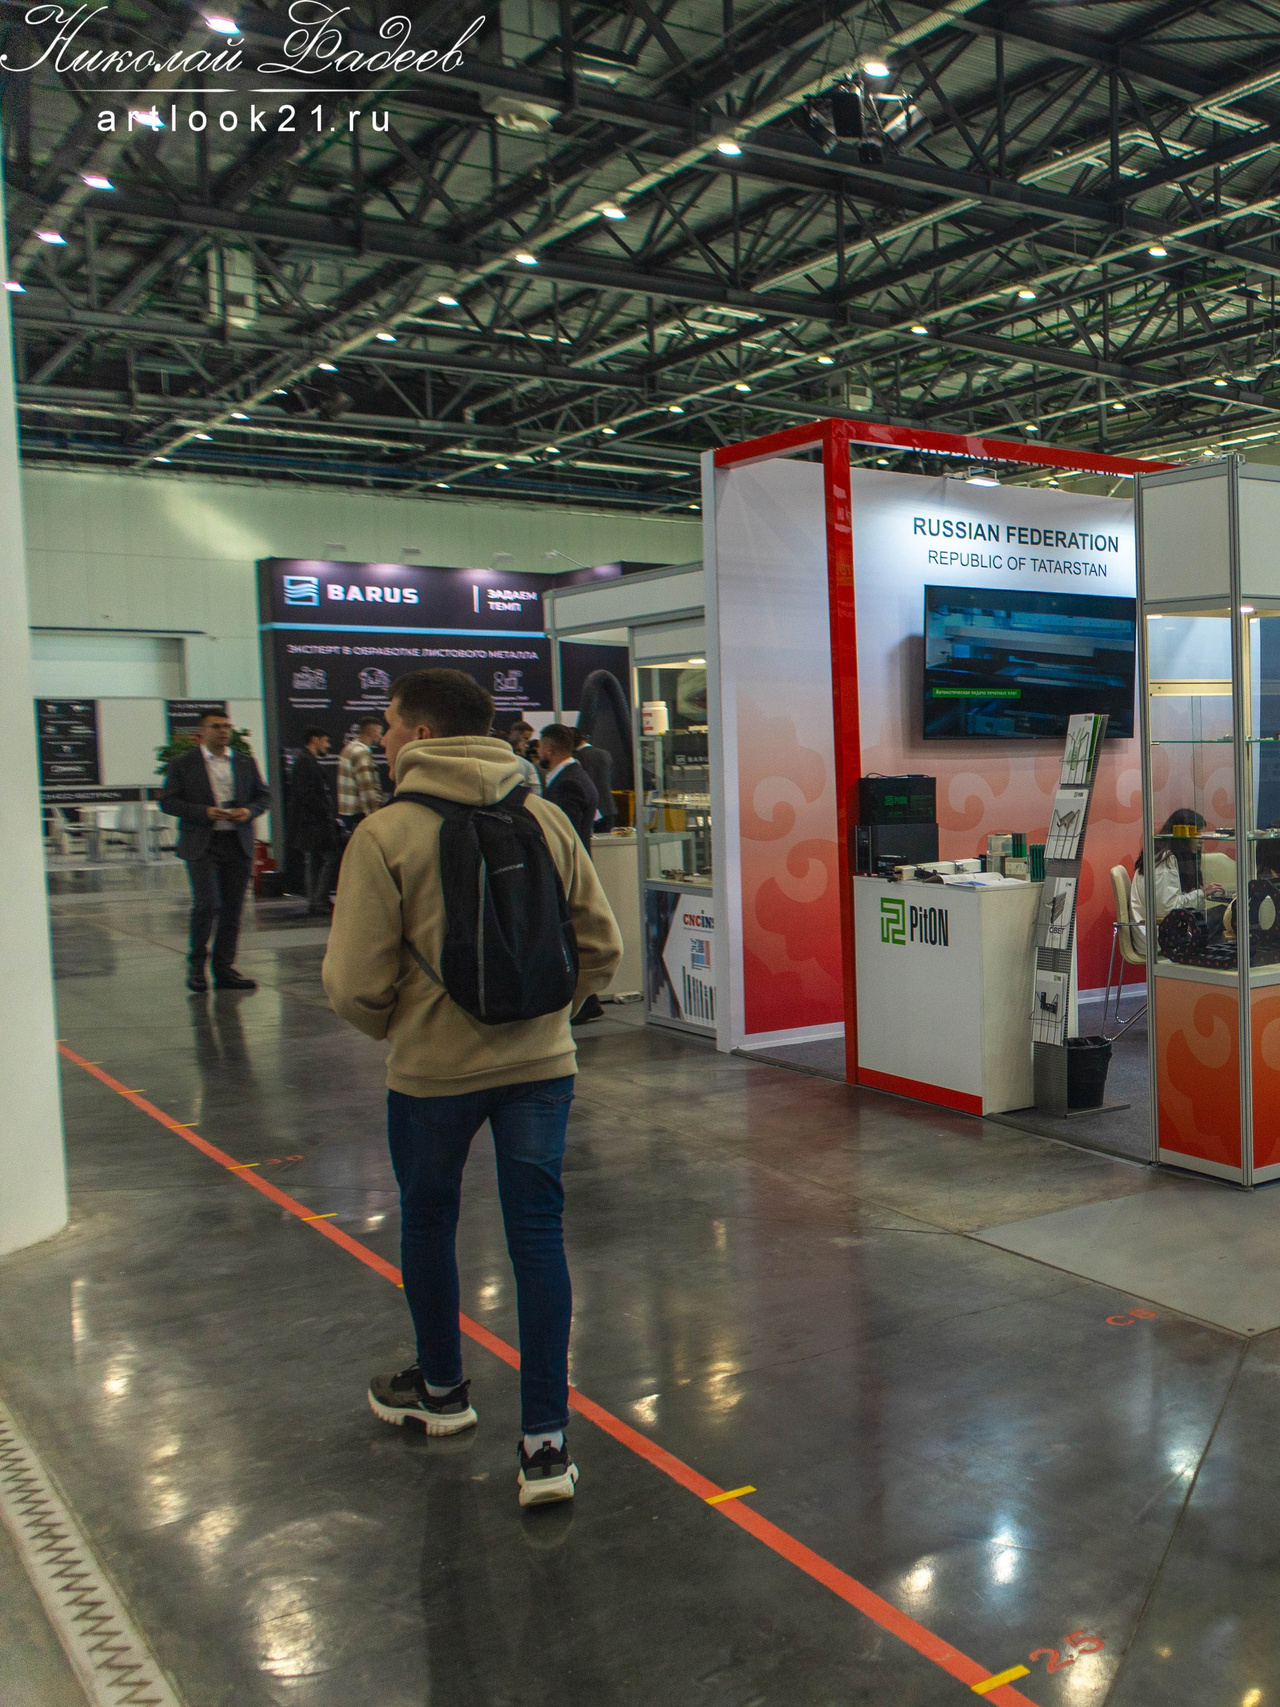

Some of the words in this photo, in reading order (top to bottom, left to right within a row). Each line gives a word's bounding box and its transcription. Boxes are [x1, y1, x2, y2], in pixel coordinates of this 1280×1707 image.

[913, 517, 1000, 543] RUSSIAN
[1006, 525, 1119, 553] FEDERATION
[928, 550, 1003, 570] REPUBLIC
[1007, 556, 1026, 571] OF
[1031, 558, 1107, 578] TATARSTAN
[326, 583, 420, 605] BARUS
[487, 601, 522, 612] ТЕМП
[421, 648, 488, 660] ЛИСТОВОГО
[488, 650, 540, 660] МЕТАЛЛА
[909, 905, 949, 947] PitON
